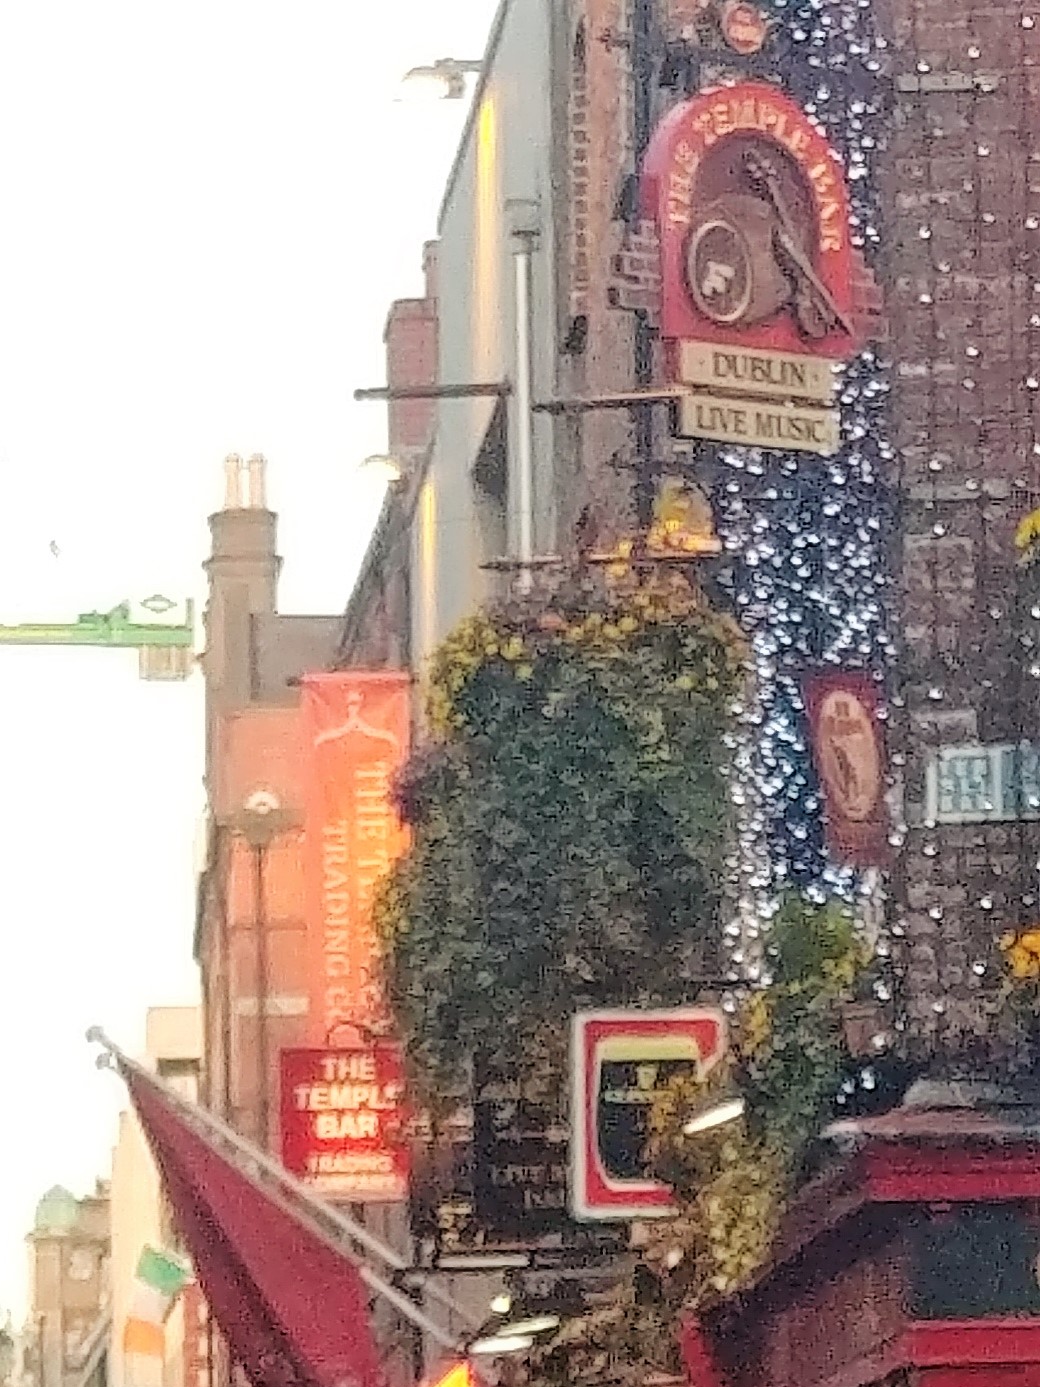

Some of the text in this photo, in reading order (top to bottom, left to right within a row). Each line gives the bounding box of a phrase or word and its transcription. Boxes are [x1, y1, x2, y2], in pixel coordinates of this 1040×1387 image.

[667, 98, 841, 252] THE TEMPLE BAR
[712, 351, 807, 387] DUBLIN
[695, 405, 826, 443] LIVE MUSIC
[322, 820, 350, 977] TRADING
[321, 1054, 377, 1081] THE
[315, 1112, 379, 1139] BAR
